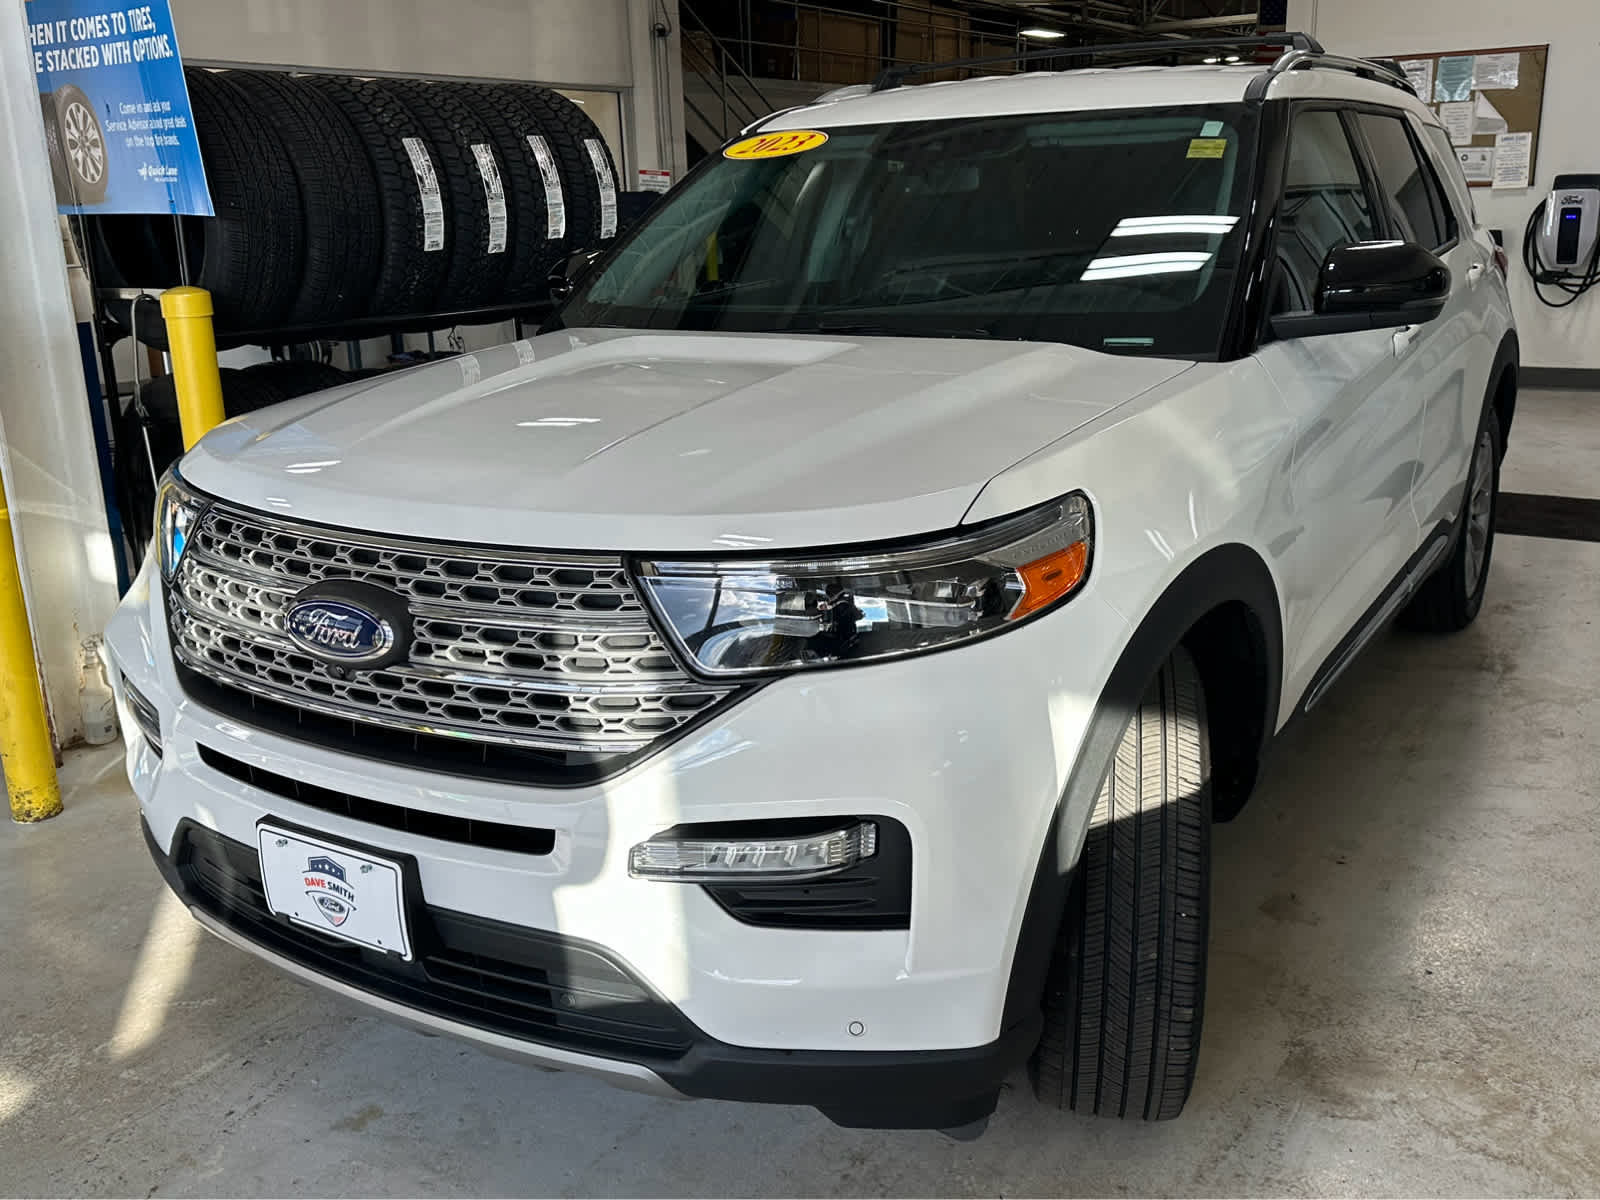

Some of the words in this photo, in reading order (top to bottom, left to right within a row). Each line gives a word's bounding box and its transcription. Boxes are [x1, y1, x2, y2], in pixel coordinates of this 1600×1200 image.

[28, 22, 54, 46] HEN
[55, 20, 67, 43] IT
[70, 14, 110, 40] COMES
[110, 11, 127, 36] TO
[127, 6, 157, 33] TIRES,
[45, 45, 100, 72] STACKED
[101, 40, 132, 66] WITH
[133, 33, 174, 63] OPTIONS.
[735, 134, 817, 153] 2023
[304, 608, 363, 649] Ford
[304, 877, 326, 888] DAVE
[327, 881, 355, 902] SMITH
